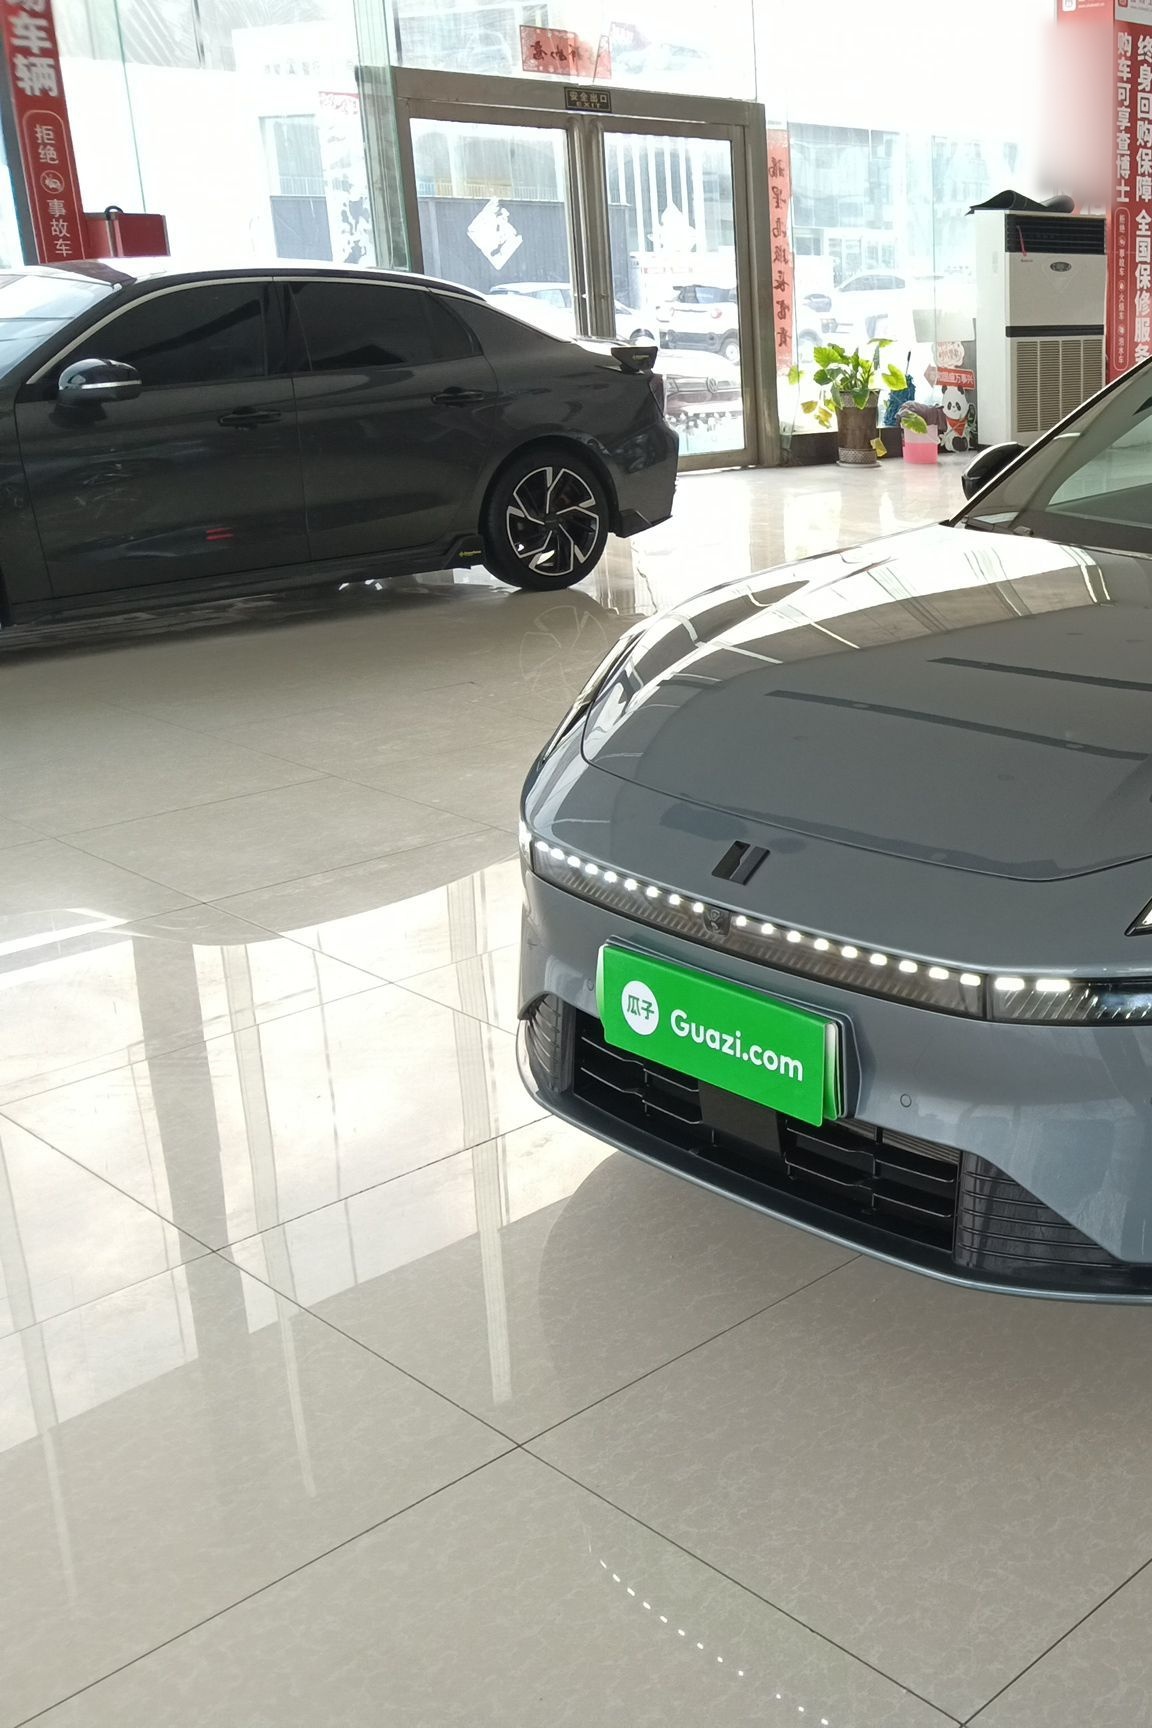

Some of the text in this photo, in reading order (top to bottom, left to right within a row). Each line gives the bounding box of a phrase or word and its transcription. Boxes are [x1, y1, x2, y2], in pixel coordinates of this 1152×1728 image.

[569, 91, 607, 103] 安全出口
[1116, 32, 1132, 203] 购车可享查博士
[34, 124, 72, 257] 拒绝 事故车
